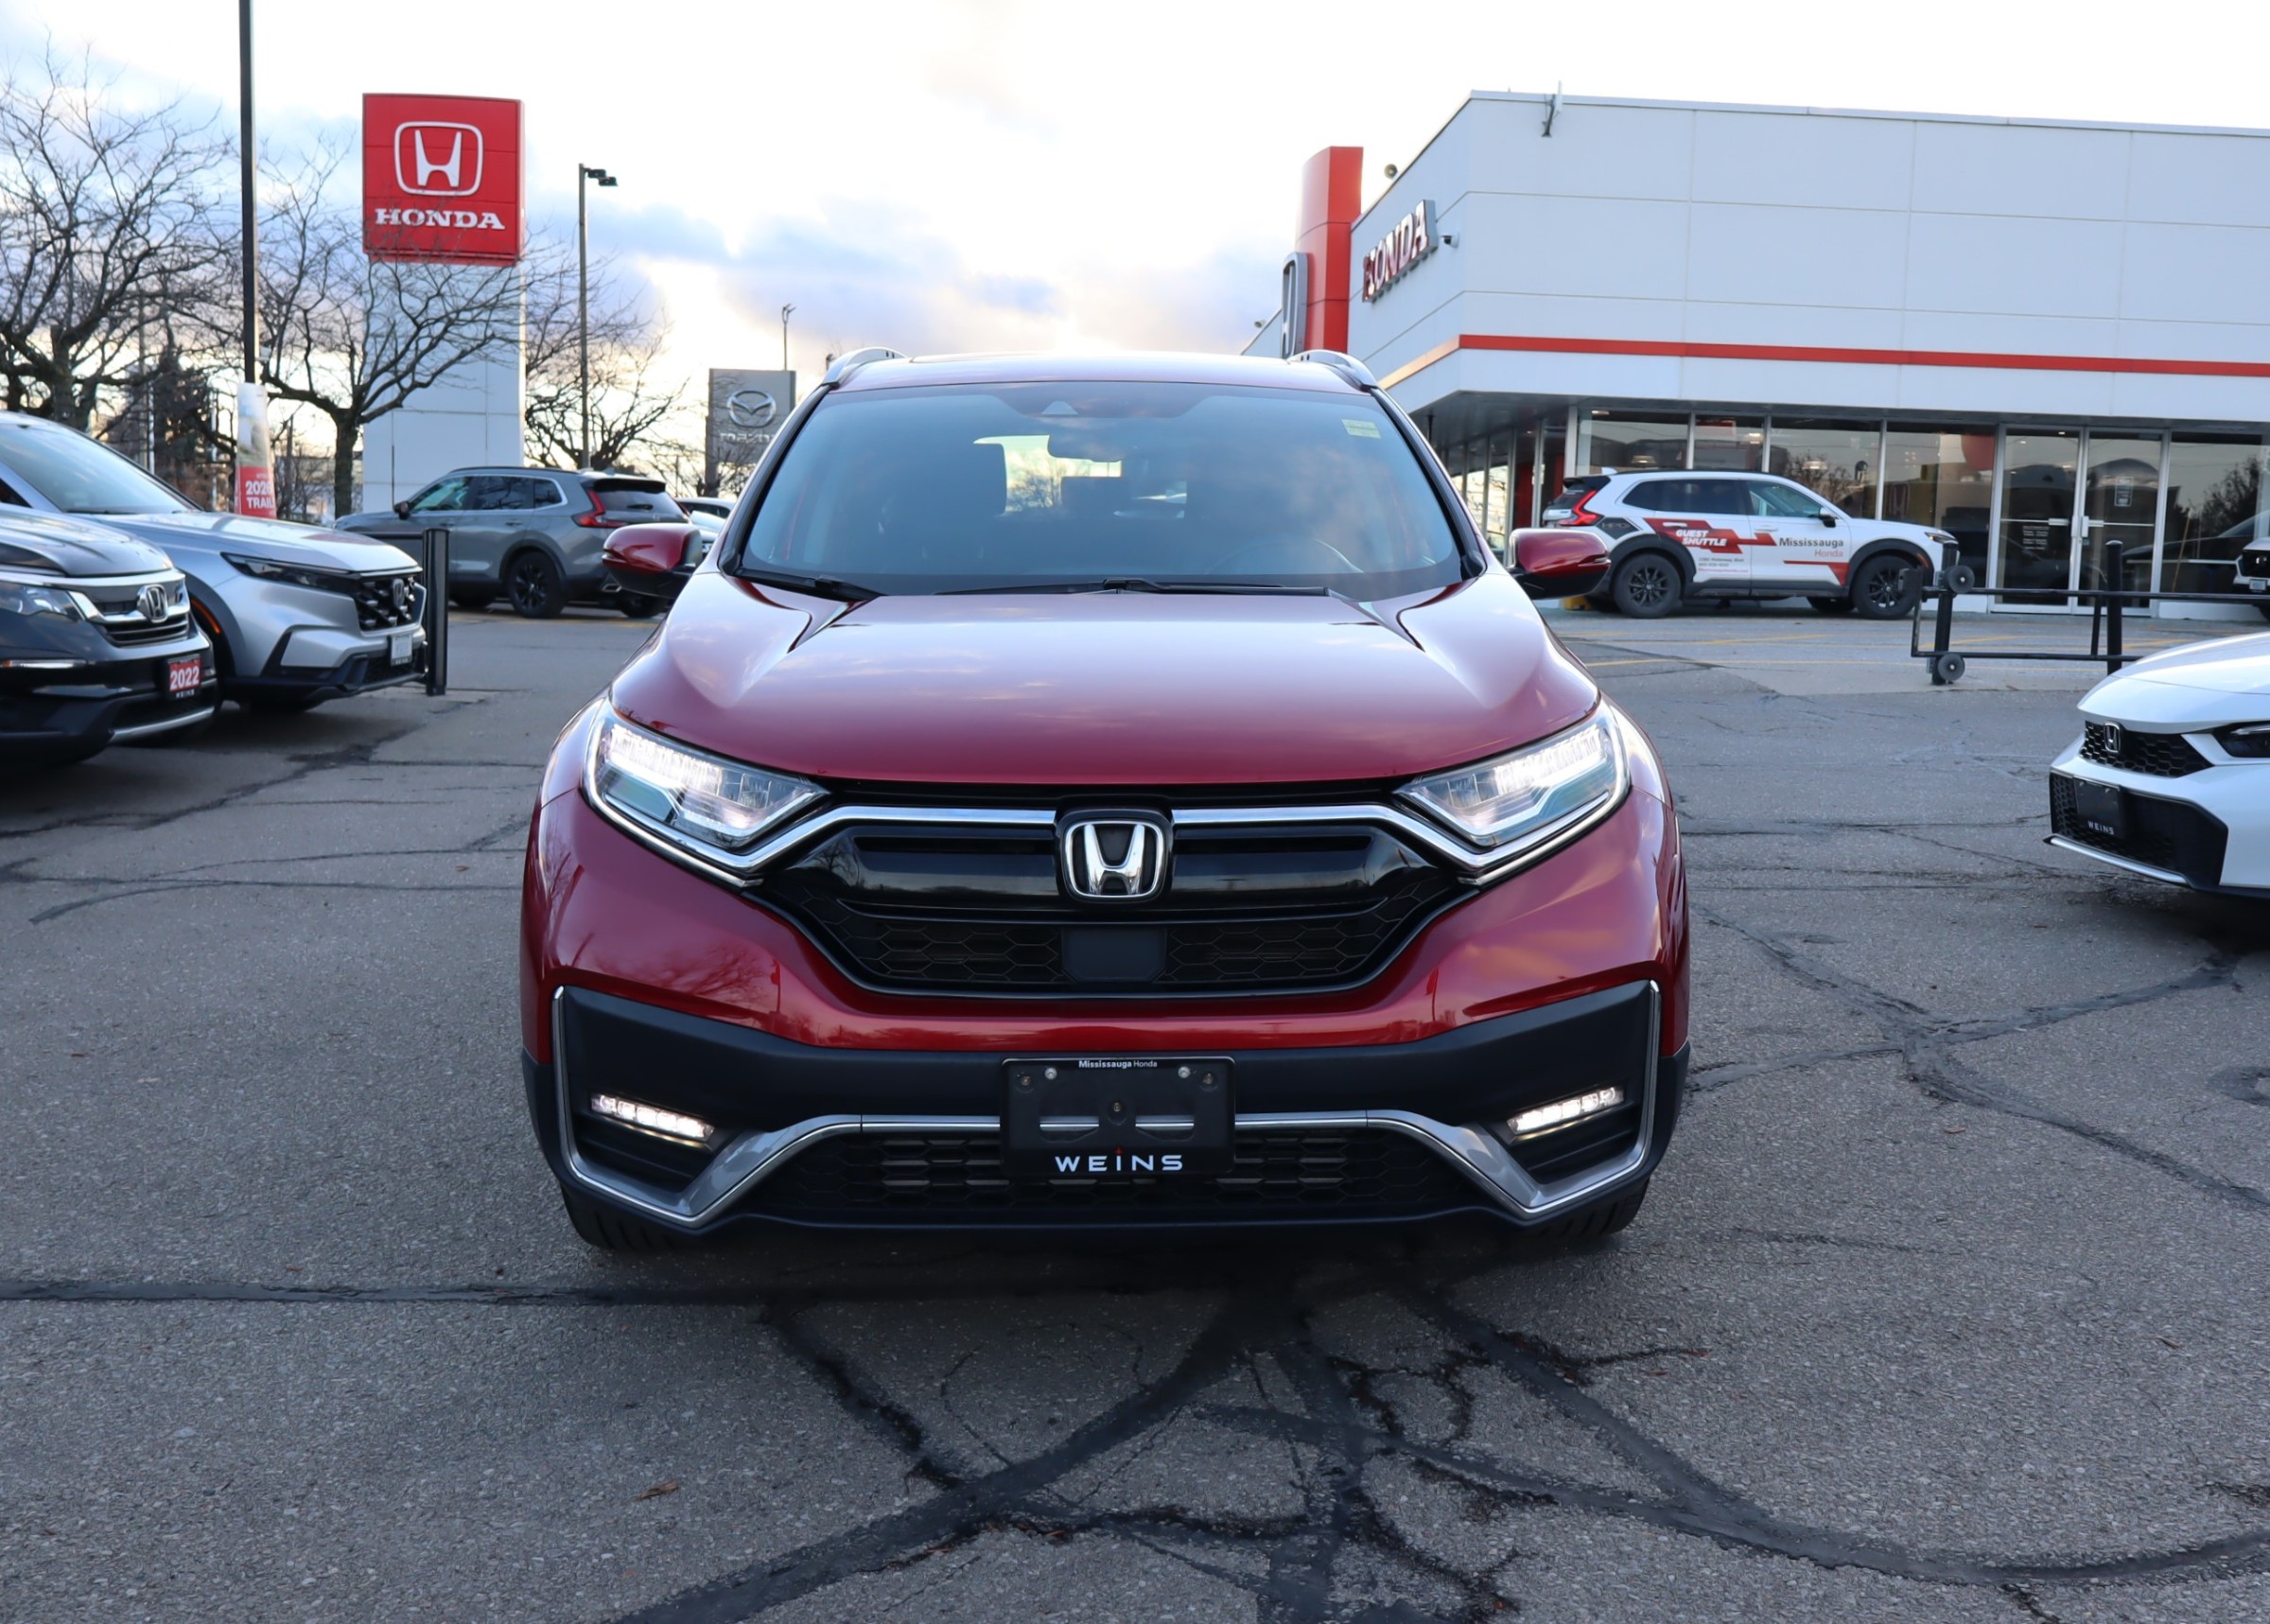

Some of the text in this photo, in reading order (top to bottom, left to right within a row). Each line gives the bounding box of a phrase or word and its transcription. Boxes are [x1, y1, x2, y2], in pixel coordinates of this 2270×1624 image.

[375, 208, 505, 230] HONDA
[1362, 200, 1431, 302] HONDA
[1675, 529, 1709, 538] GUEST
[1681, 537, 1728, 547] SHUTTLE
[1779, 537, 1843, 549] Mississauga
[1814, 549, 1843, 557] Honda
[170, 665, 200, 691] 2022
[1078, 1060, 1132, 1070] Mississauga
[1055, 1154, 1183, 1173] WEINS
